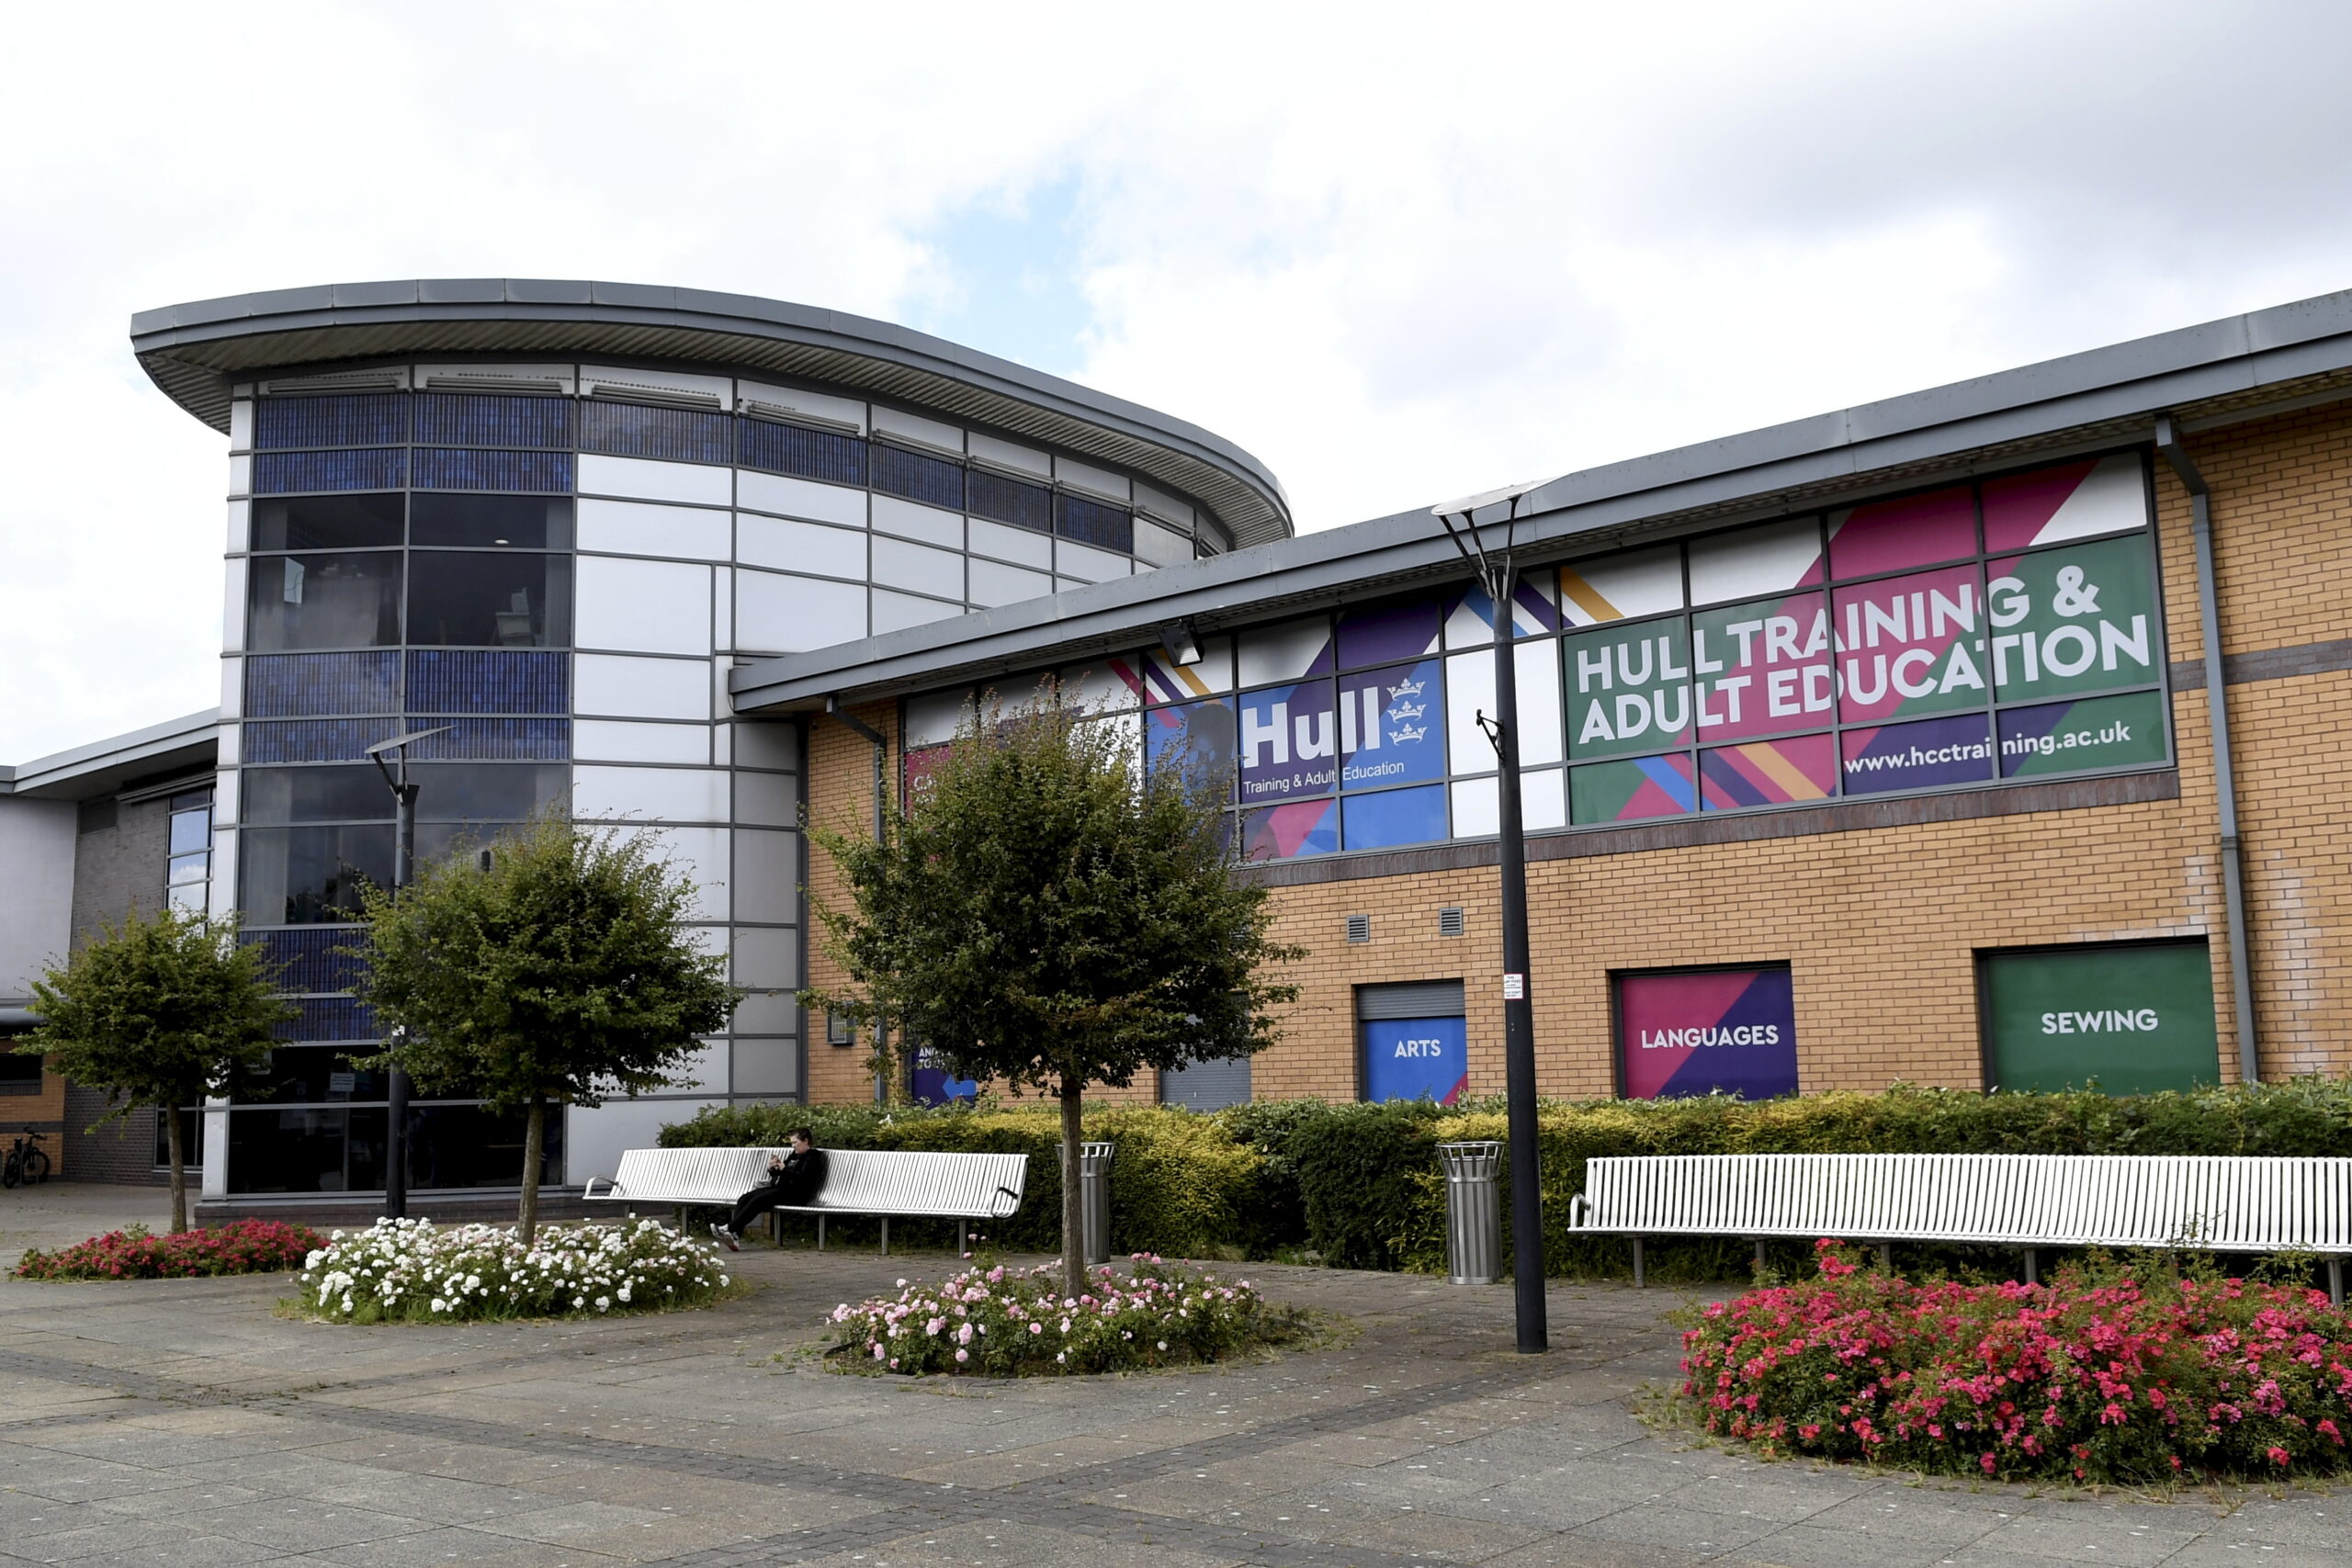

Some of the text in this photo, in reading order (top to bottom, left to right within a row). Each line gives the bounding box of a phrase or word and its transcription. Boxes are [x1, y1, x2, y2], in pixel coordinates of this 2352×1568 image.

[1577, 565, 2102, 694] HULL TRAINING &
[1578, 615, 2150, 745] ADULT EDUCATION
[1242, 686, 1381, 769] Hull
[1844, 720, 2132, 774] www.hcctraining.ac.uk
[1243, 761, 1405, 795] Training & Adult Education
[1641, 1024, 1780, 1049] LANGUAGES
[2041, 1009, 2159, 1034] SEWING
[1394, 1039, 1442, 1057] ARTS
